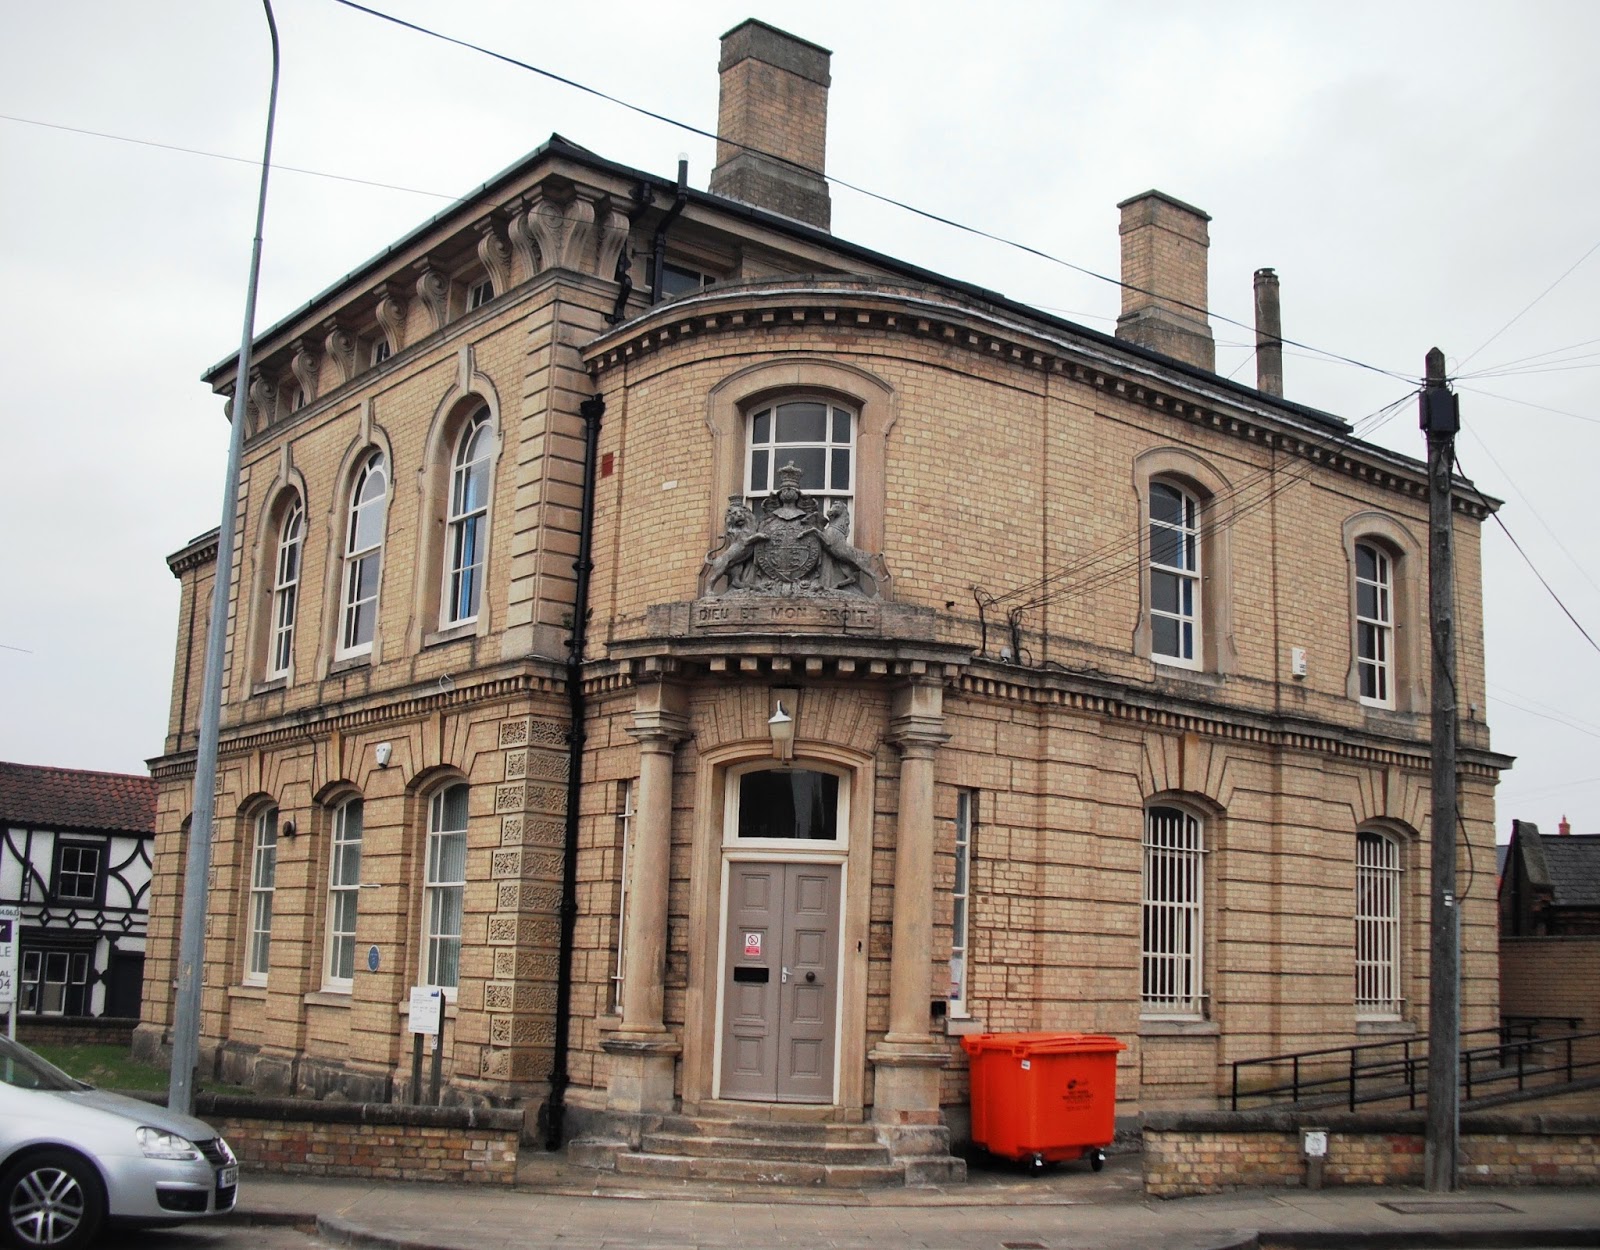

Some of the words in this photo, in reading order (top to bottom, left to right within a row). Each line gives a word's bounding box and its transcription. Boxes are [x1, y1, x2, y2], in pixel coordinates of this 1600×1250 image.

[700, 607, 729, 621] DIEU
[740, 607, 759, 619] ET
[770, 607, 807, 620] MON
